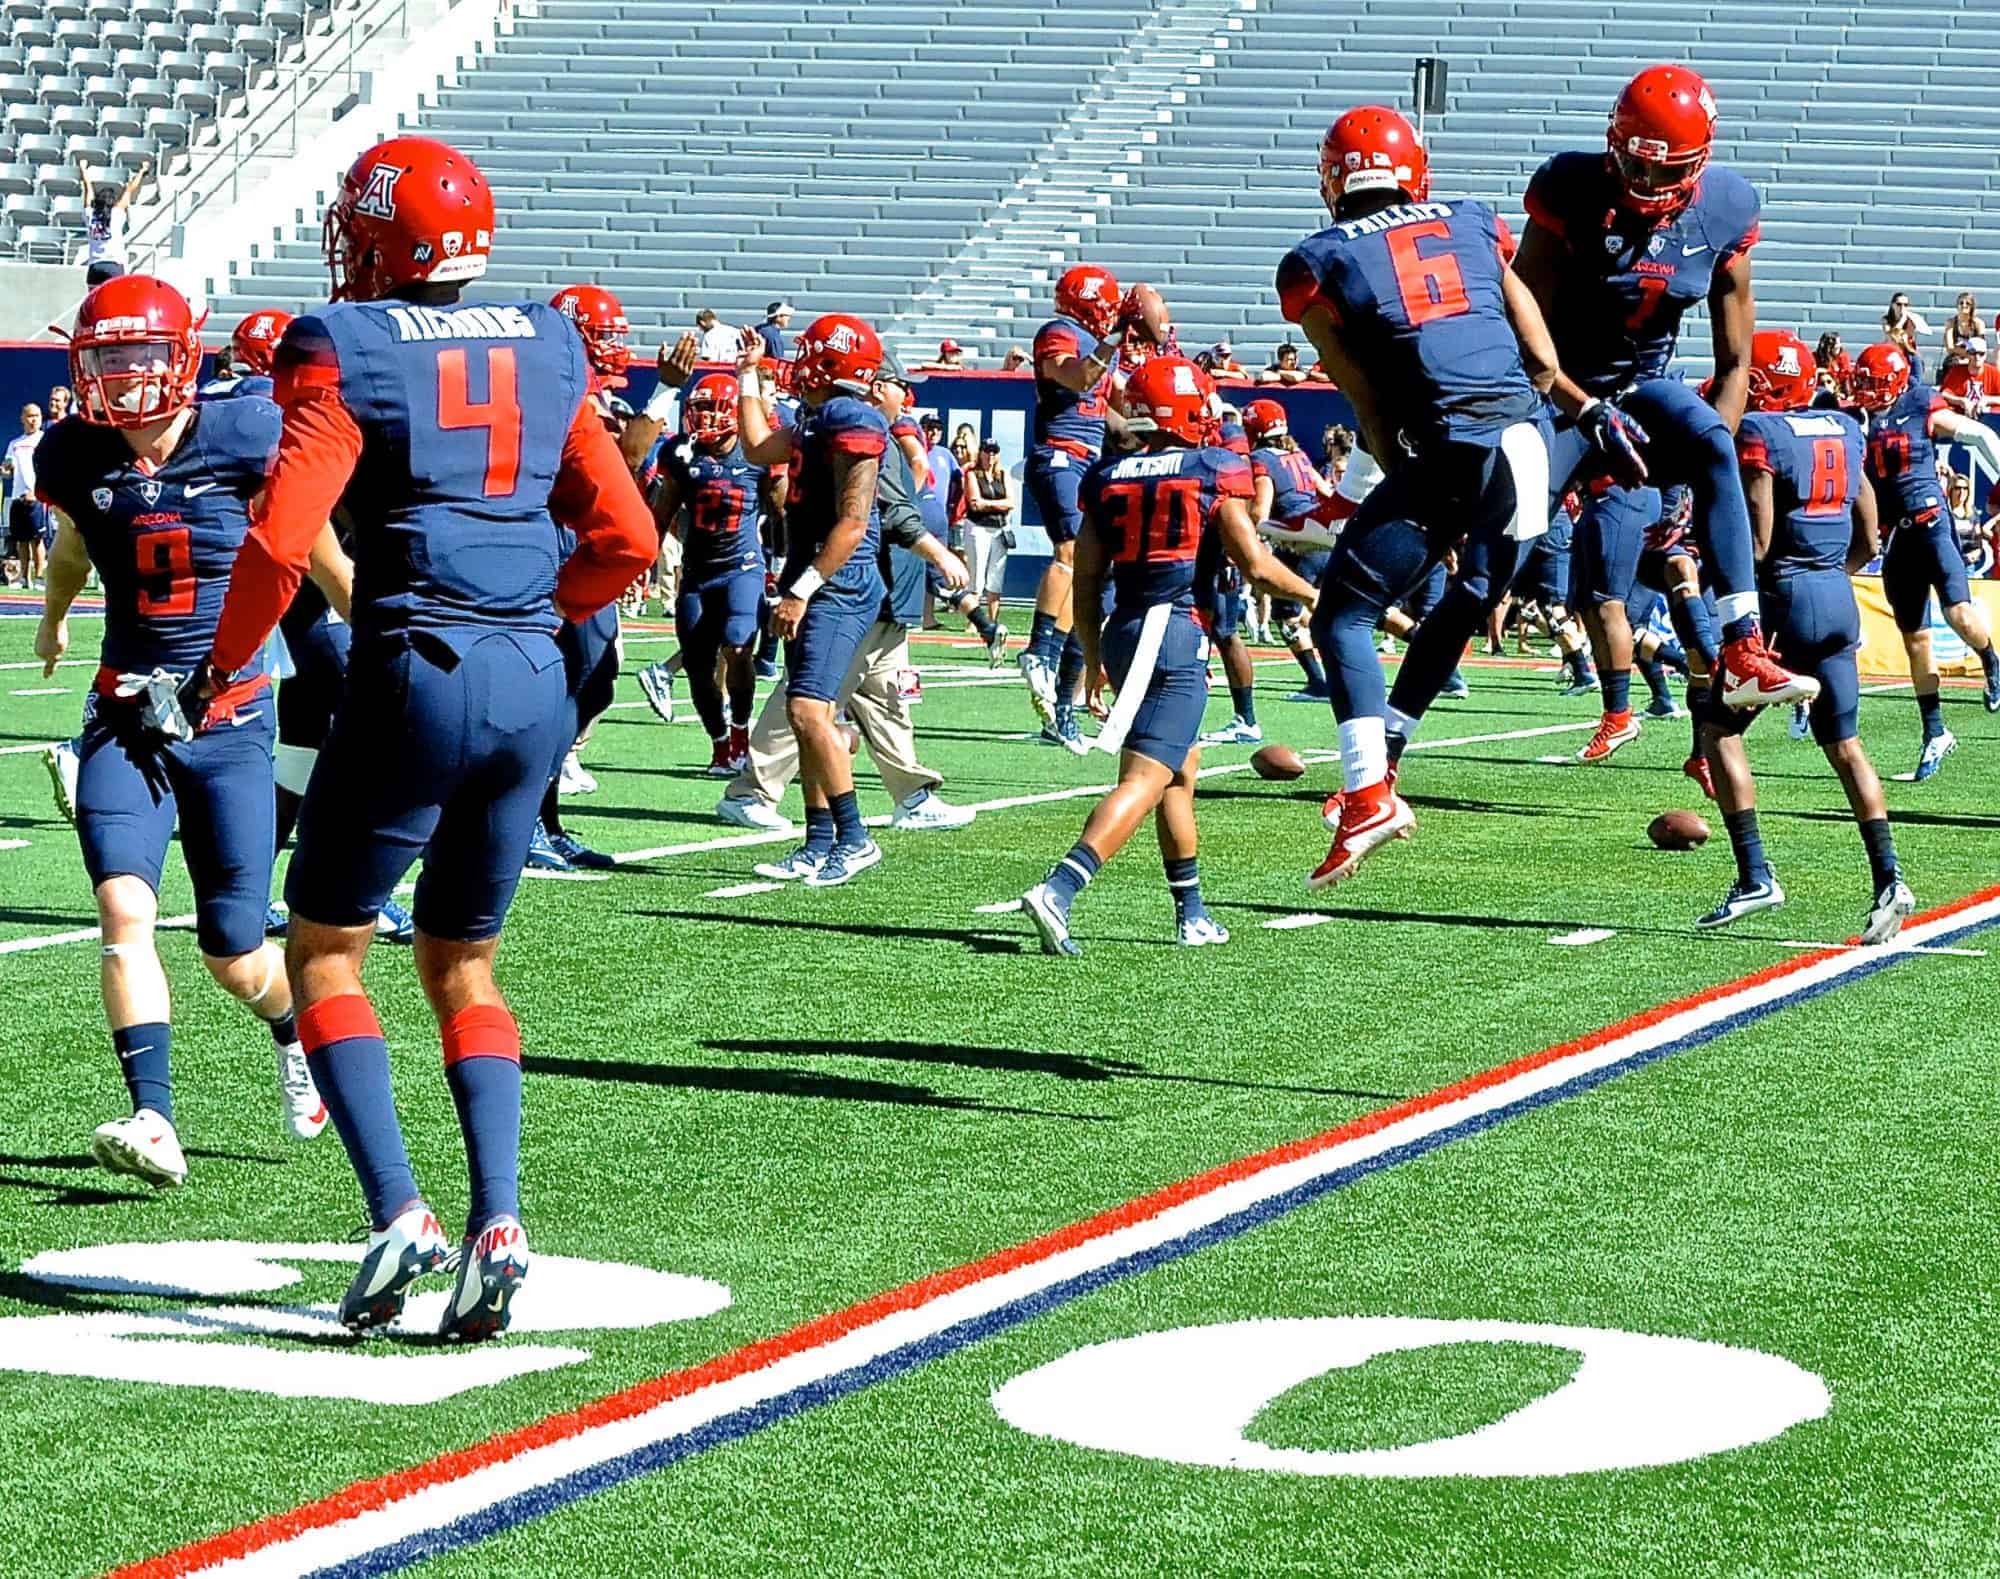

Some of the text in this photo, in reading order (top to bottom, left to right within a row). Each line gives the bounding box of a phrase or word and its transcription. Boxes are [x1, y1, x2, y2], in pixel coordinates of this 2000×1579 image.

[355, 163, 401, 221] A
[1338, 202, 1453, 239] PHILLIPS
[1385, 219, 1471, 328] 6
[386, 305, 536, 341] NICHOLS
[1625, 278, 1668, 329] 7
[824, 324, 858, 354] A
[1776, 345, 1801, 376] A
[437, 346, 521, 497] 4
[1111, 452, 1184, 479] JACKSON
[1805, 438, 1848, 516] 8
[1101, 479, 1203, 563] 30
[137, 528, 196, 616] 9
